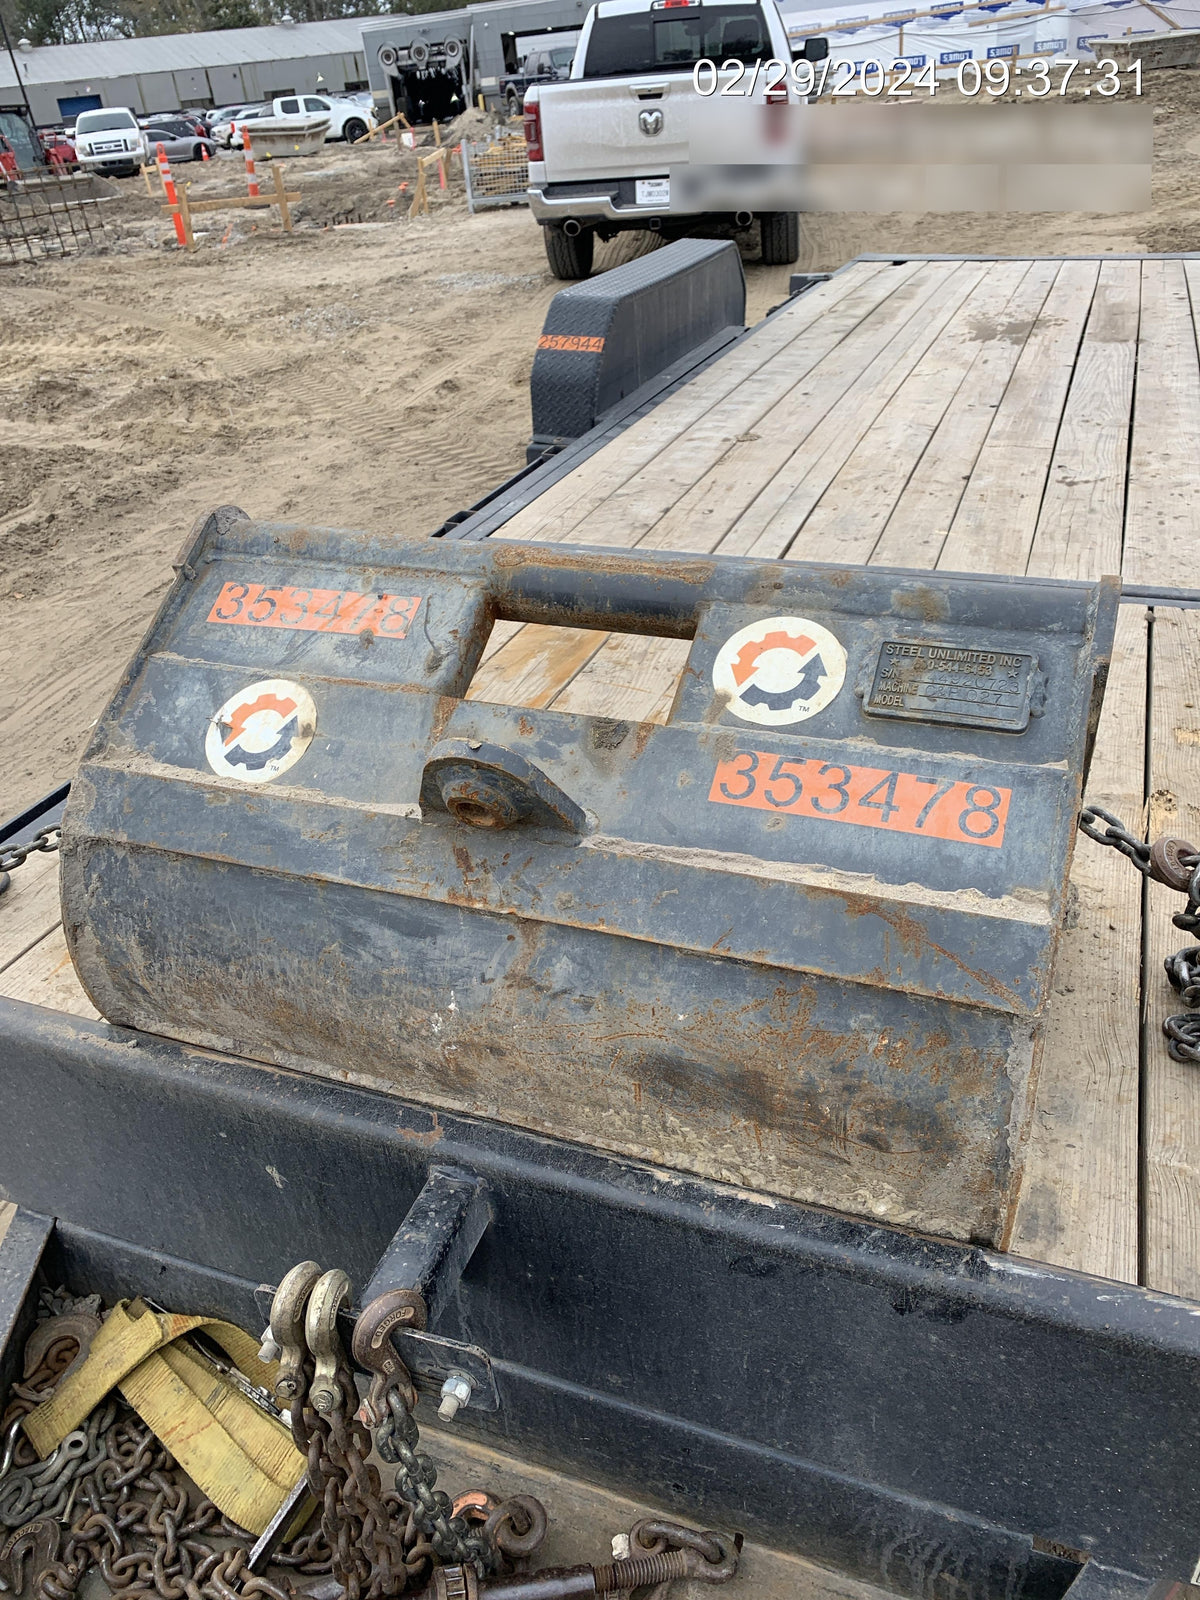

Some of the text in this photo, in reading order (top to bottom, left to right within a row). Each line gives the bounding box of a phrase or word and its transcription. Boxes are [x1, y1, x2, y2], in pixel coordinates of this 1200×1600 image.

[538, 335, 602, 350] 257944
[216, 583, 414, 633] 353478
[886, 644, 1022, 668] STEEL UNLIMITED INC
[873, 694, 905, 707] MODEL
[878, 681, 919, 696] MACHINE
[719, 750, 1002, 839] 353478
[375, 1309, 407, 1337] FORGED
